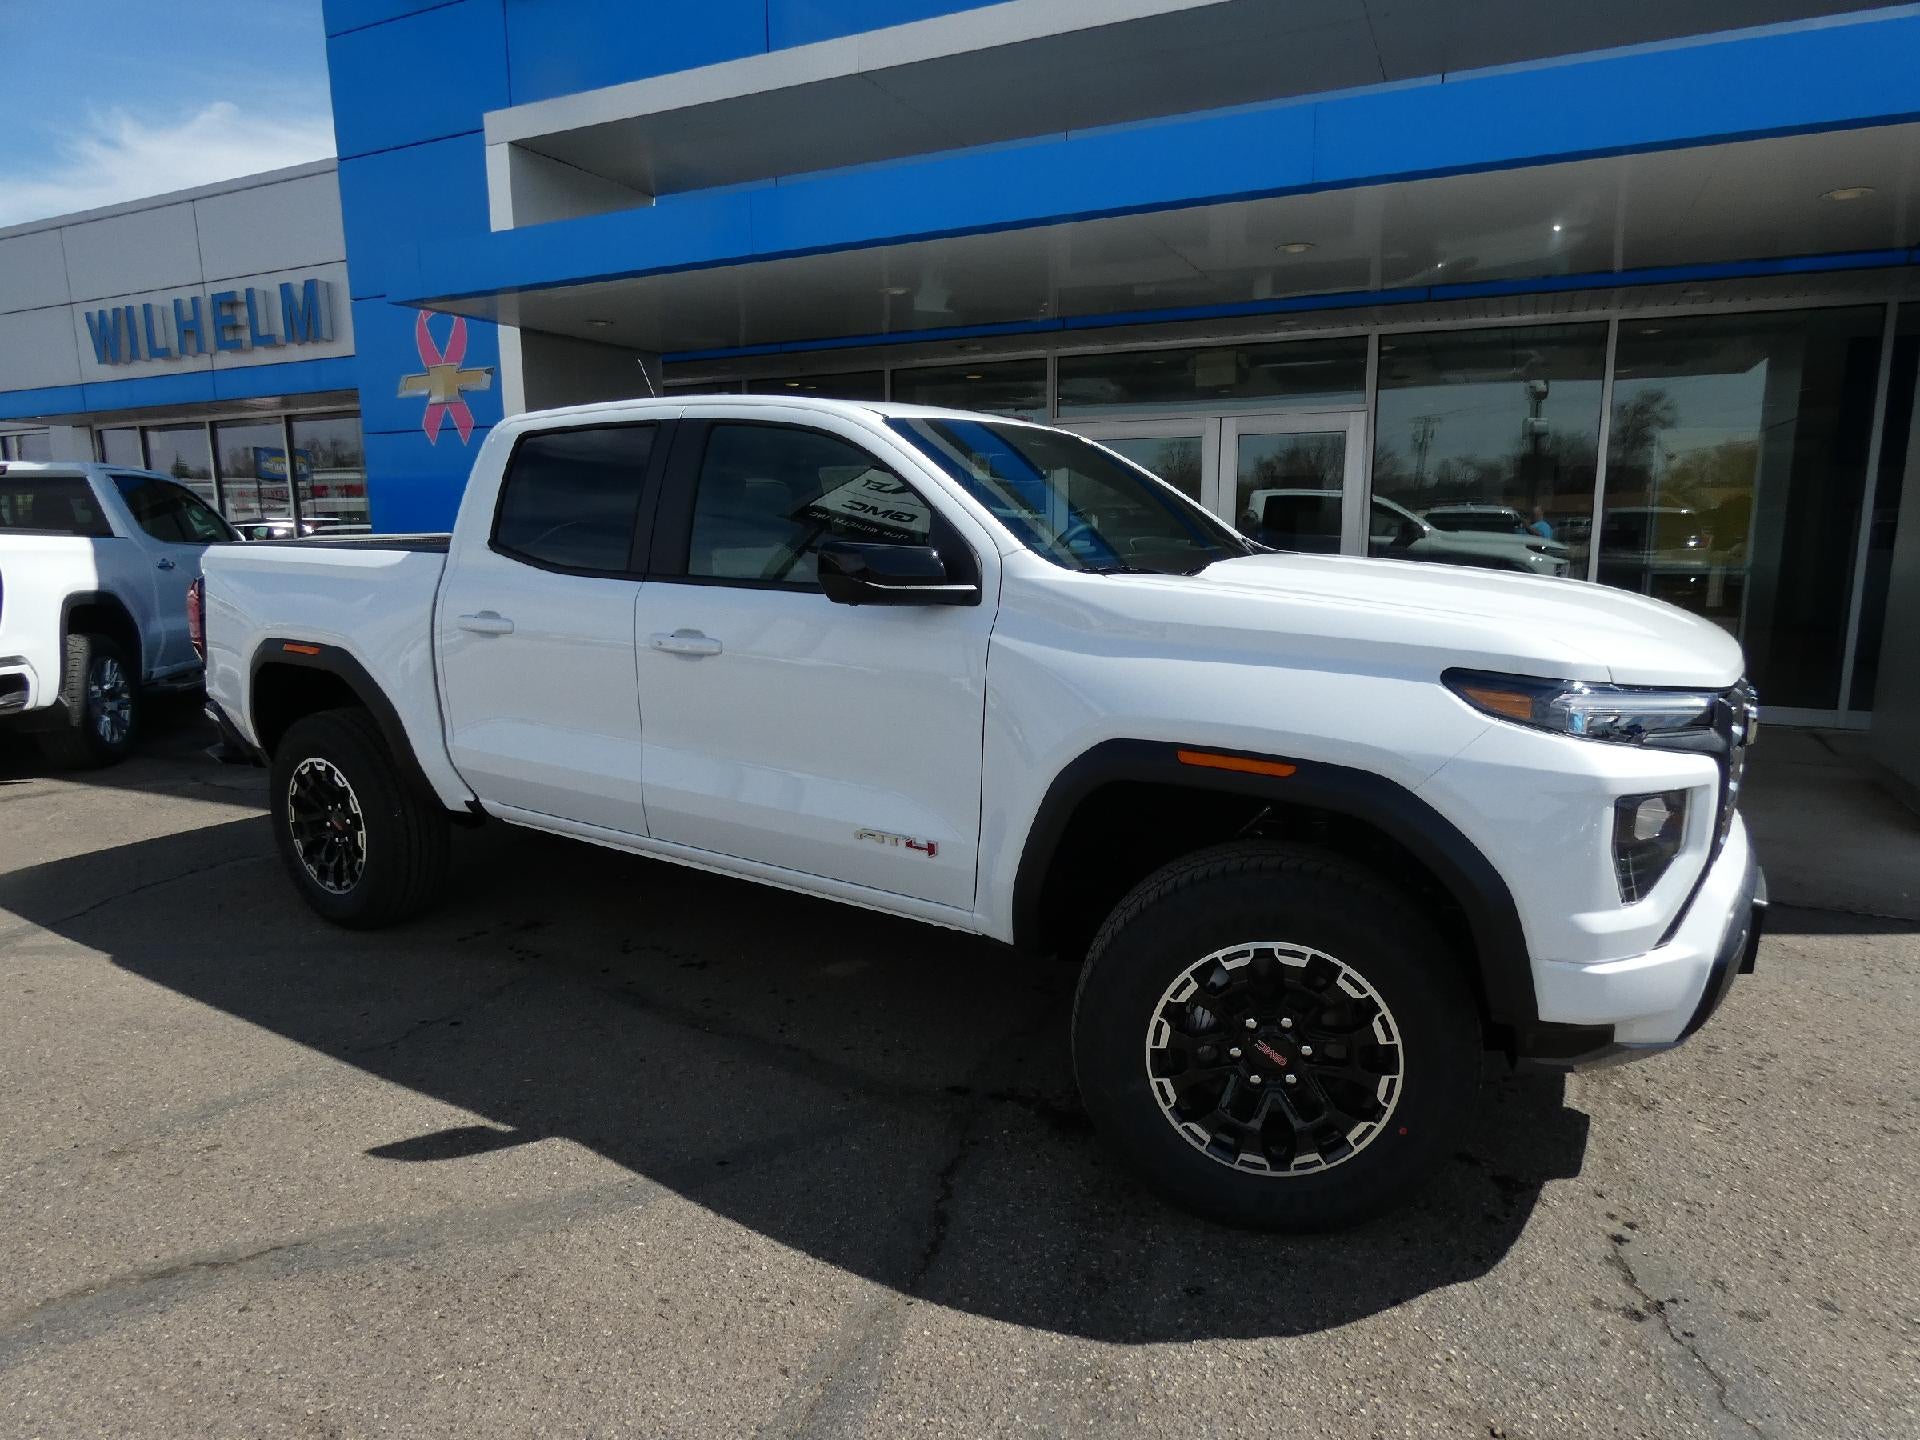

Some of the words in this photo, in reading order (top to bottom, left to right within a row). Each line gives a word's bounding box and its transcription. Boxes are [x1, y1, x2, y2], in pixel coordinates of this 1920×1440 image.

[85, 279, 331, 365] WILHELM
[854, 828, 938, 858] AT4
[1254, 1039, 1288, 1066] GMC
